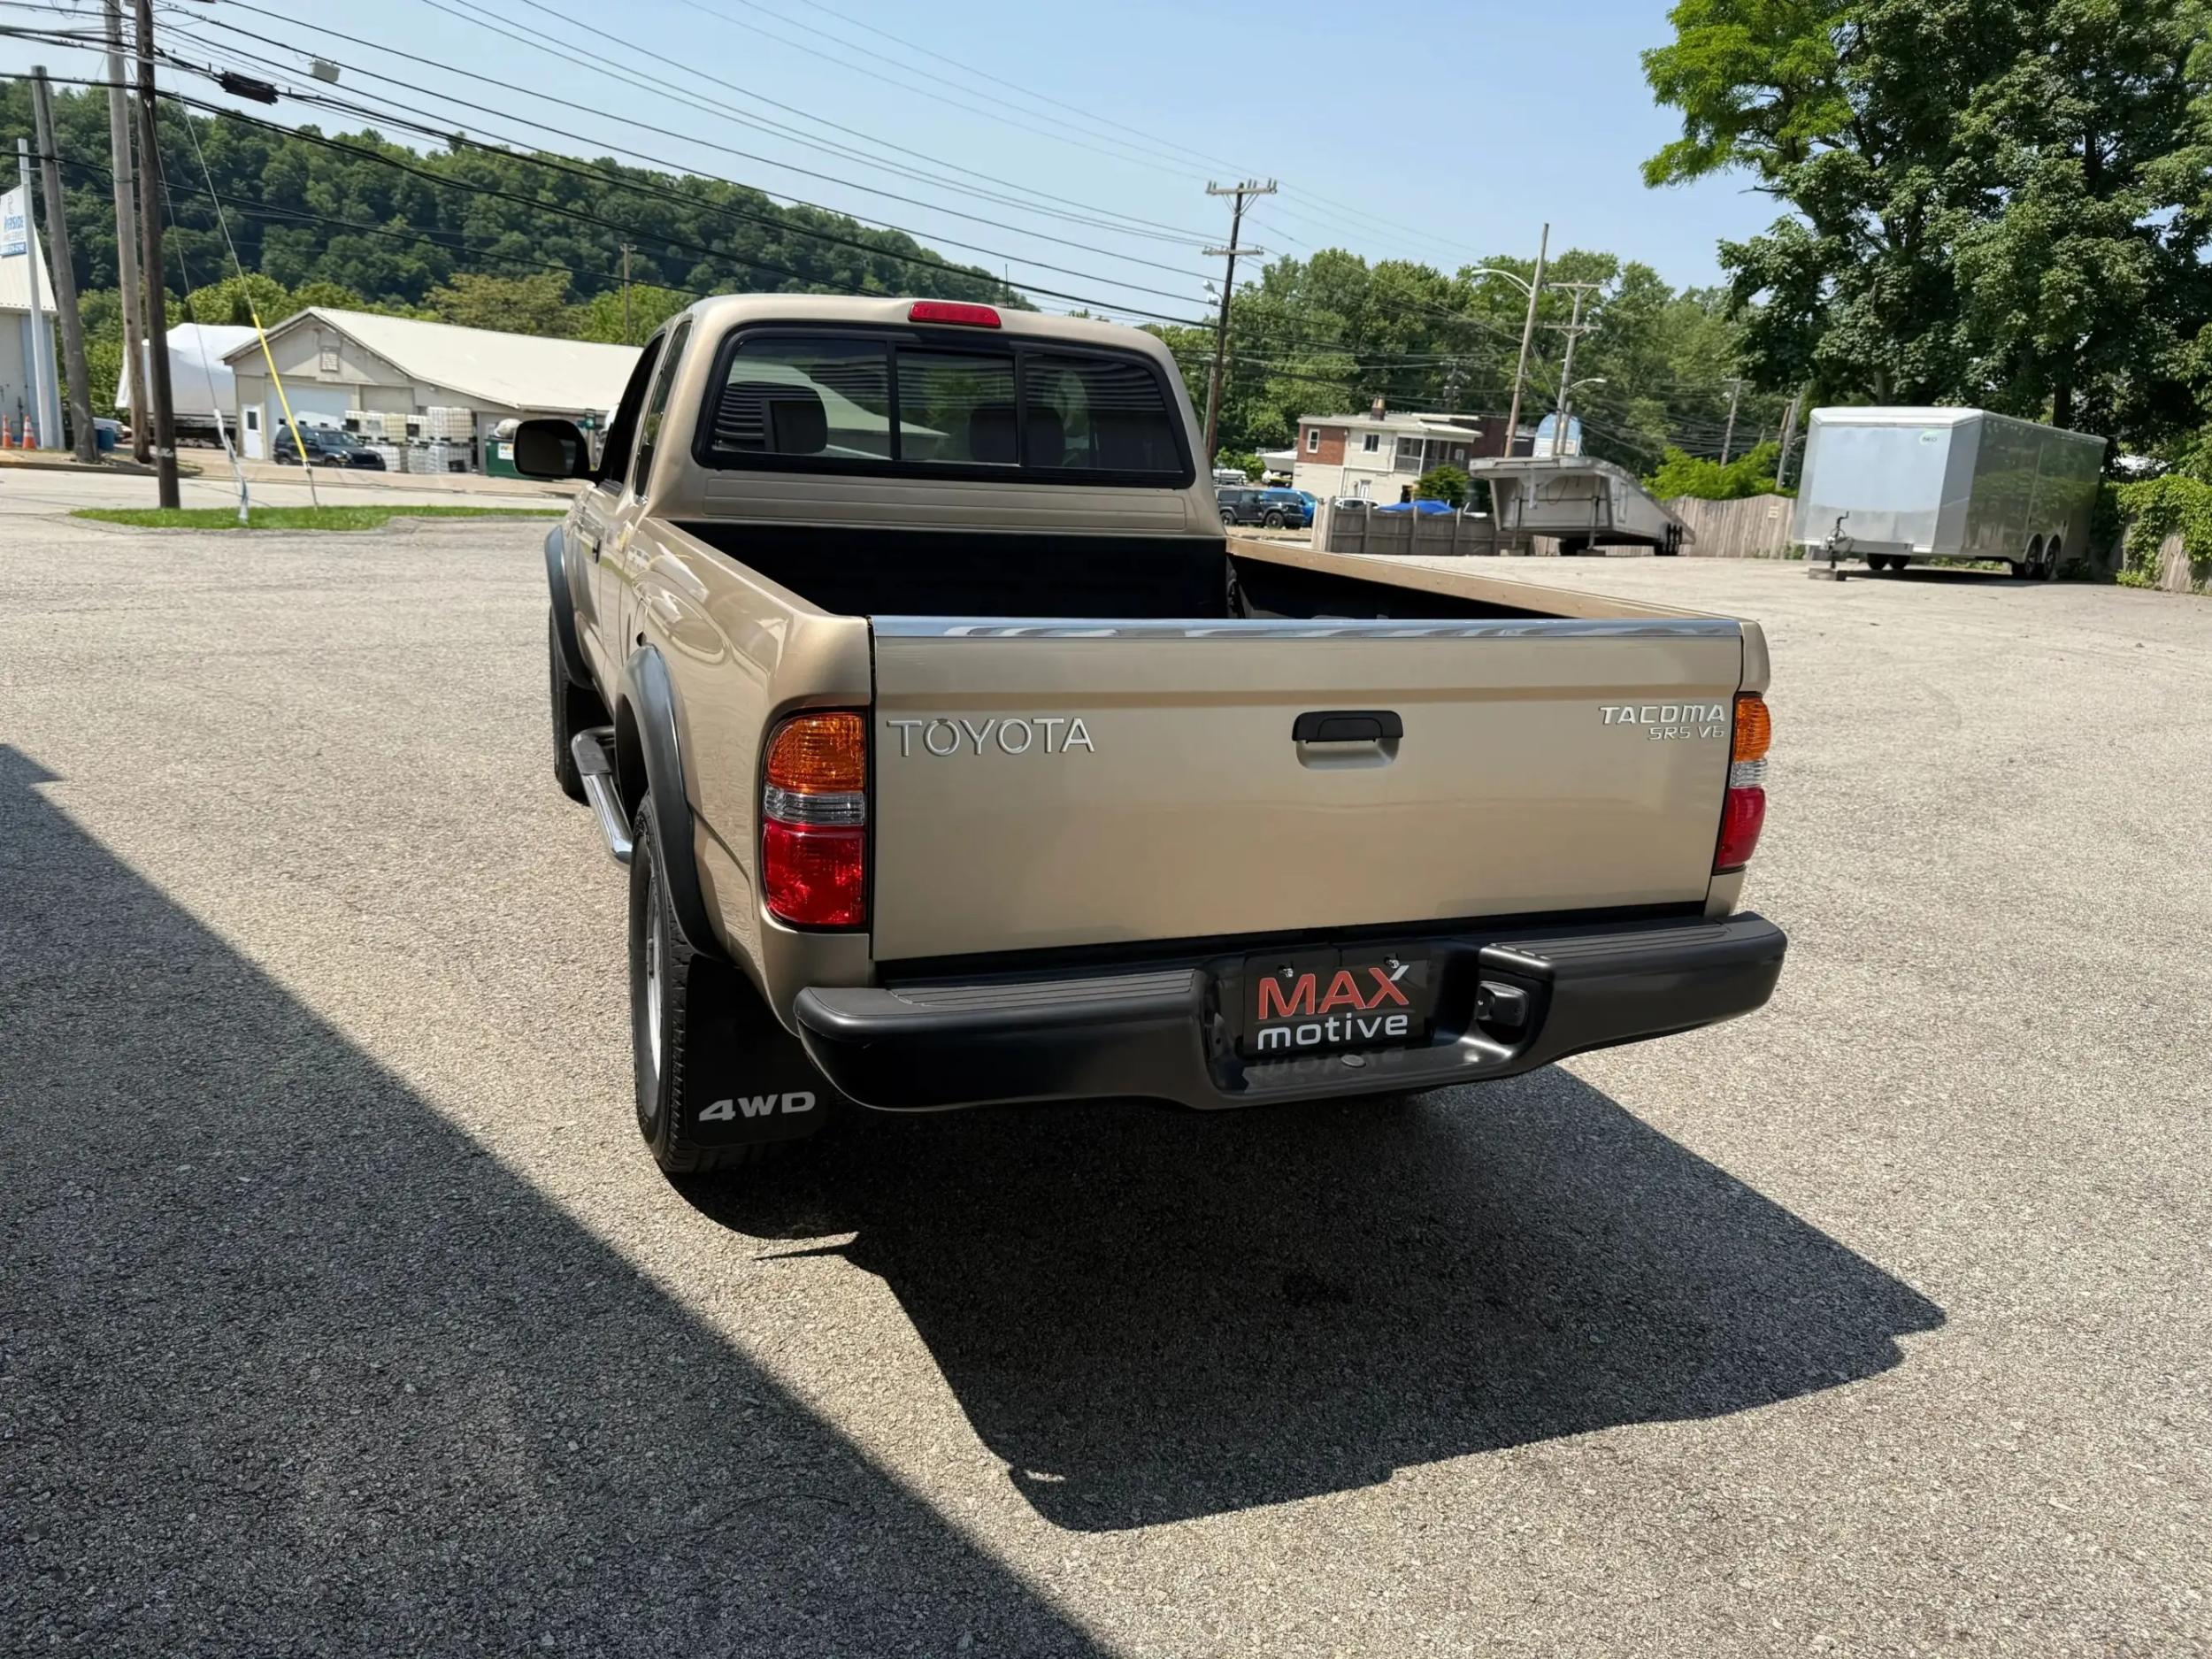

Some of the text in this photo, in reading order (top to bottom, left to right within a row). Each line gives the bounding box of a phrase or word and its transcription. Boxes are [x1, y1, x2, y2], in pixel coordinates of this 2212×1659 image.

[1599, 703, 1726, 725] TACOMA
[886, 717, 1094, 757] TOYOTA
[1648, 725, 1724, 741] SR5 V6
[1257, 964, 1409, 1020] MAX
[1257, 1012, 1409, 1050] motive
[698, 1091, 816, 1122] 4WD
